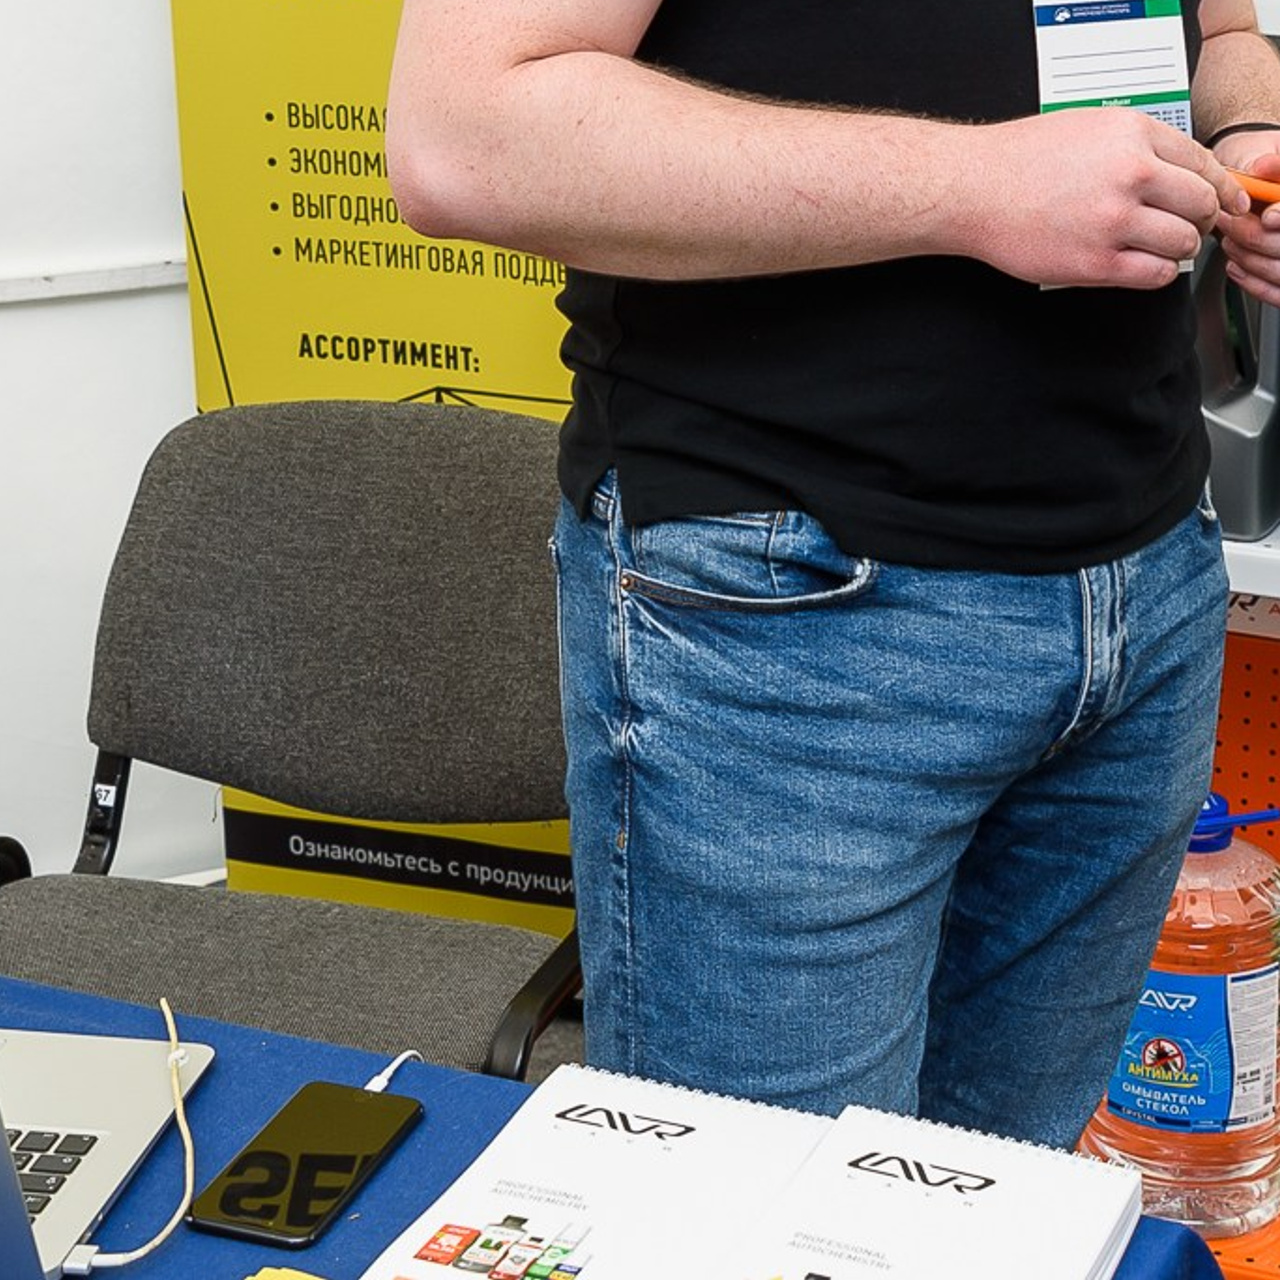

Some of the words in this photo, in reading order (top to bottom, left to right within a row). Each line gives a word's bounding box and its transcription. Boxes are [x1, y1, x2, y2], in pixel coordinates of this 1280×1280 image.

[289, 147, 388, 179] ЭКОНОМ
[293, 192, 406, 227] ВЫГОДНО
[294, 236, 484, 277] МАРКЕТИНГОВАЯ
[299, 333, 480, 373] АССОРТИМЕНТ:
[289, 834, 442, 875] Ознакомьтесь
[447, 859, 461, 877] с
[1128, 1062, 1199, 1083] АНТИМУХА
[1122, 1082, 1206, 1106] ОМЫВАТЕЛЬ
[1136, 1098, 1189, 1116] СТЕКОЛ
[555, 1104, 696, 1140] LAVR
[847, 1152, 996, 1194] LAVR
